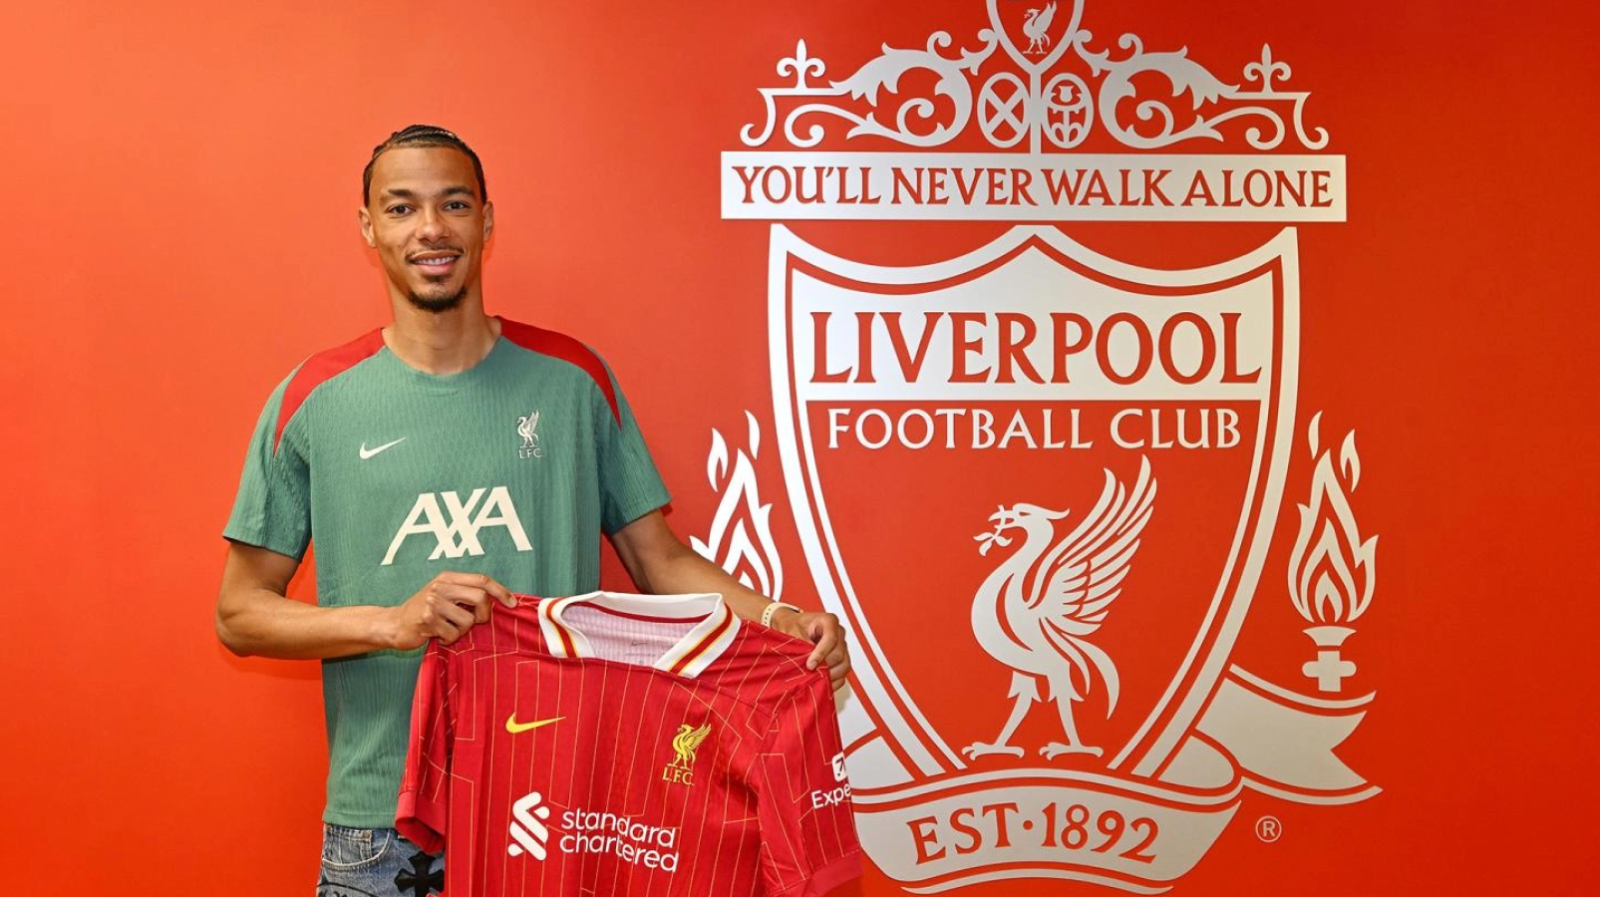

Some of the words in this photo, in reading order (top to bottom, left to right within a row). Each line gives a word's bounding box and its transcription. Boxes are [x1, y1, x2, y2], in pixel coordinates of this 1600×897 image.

[732, 164, 880, 204] YOU'LL
[891, 166, 1036, 206] NEVER
[1041, 168, 1174, 207] WALK
[1182, 169, 1333, 208] ALONE
[810, 311, 1262, 385] LIVERPOOL
[827, 408, 1093, 450] FOOTBALL
[1110, 409, 1241, 450] CLUB
[381, 486, 533, 566] AXA
[561, 807, 676, 848] standard
[559, 832, 679, 873] chartered
